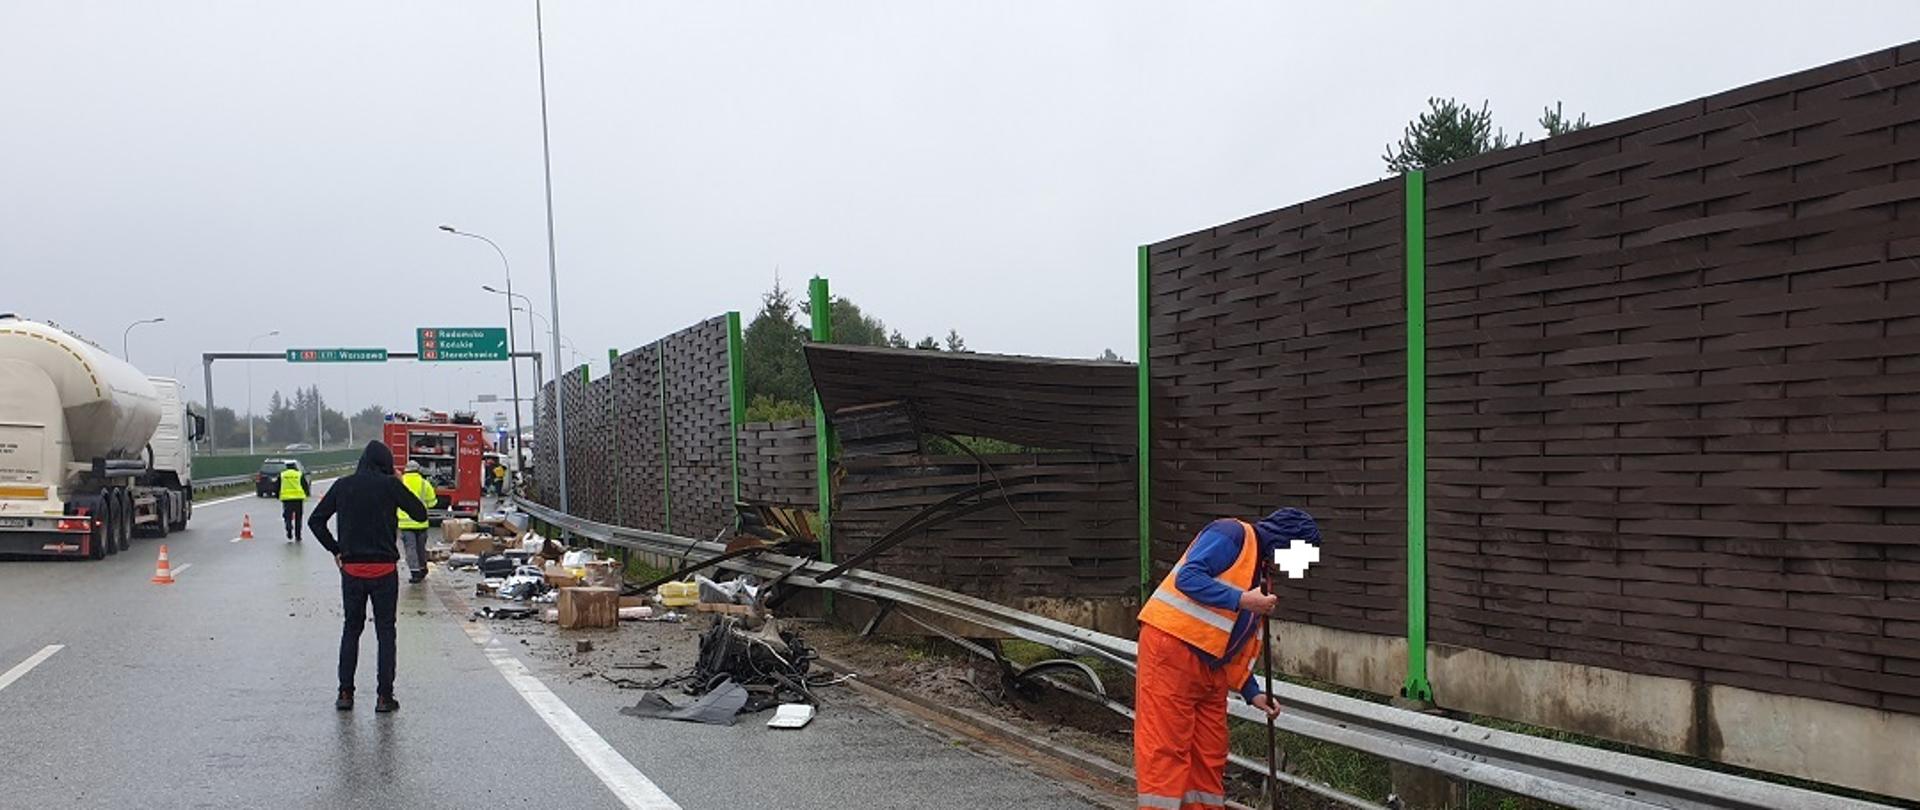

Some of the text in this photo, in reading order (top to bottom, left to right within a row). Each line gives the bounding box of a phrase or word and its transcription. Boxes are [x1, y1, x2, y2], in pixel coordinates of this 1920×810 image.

[439, 330, 485, 338] Radomsko
[440, 340, 474, 348] Końskie
[340, 351, 384, 360] Warszawa
[440, 351, 499, 359] Starachowice
